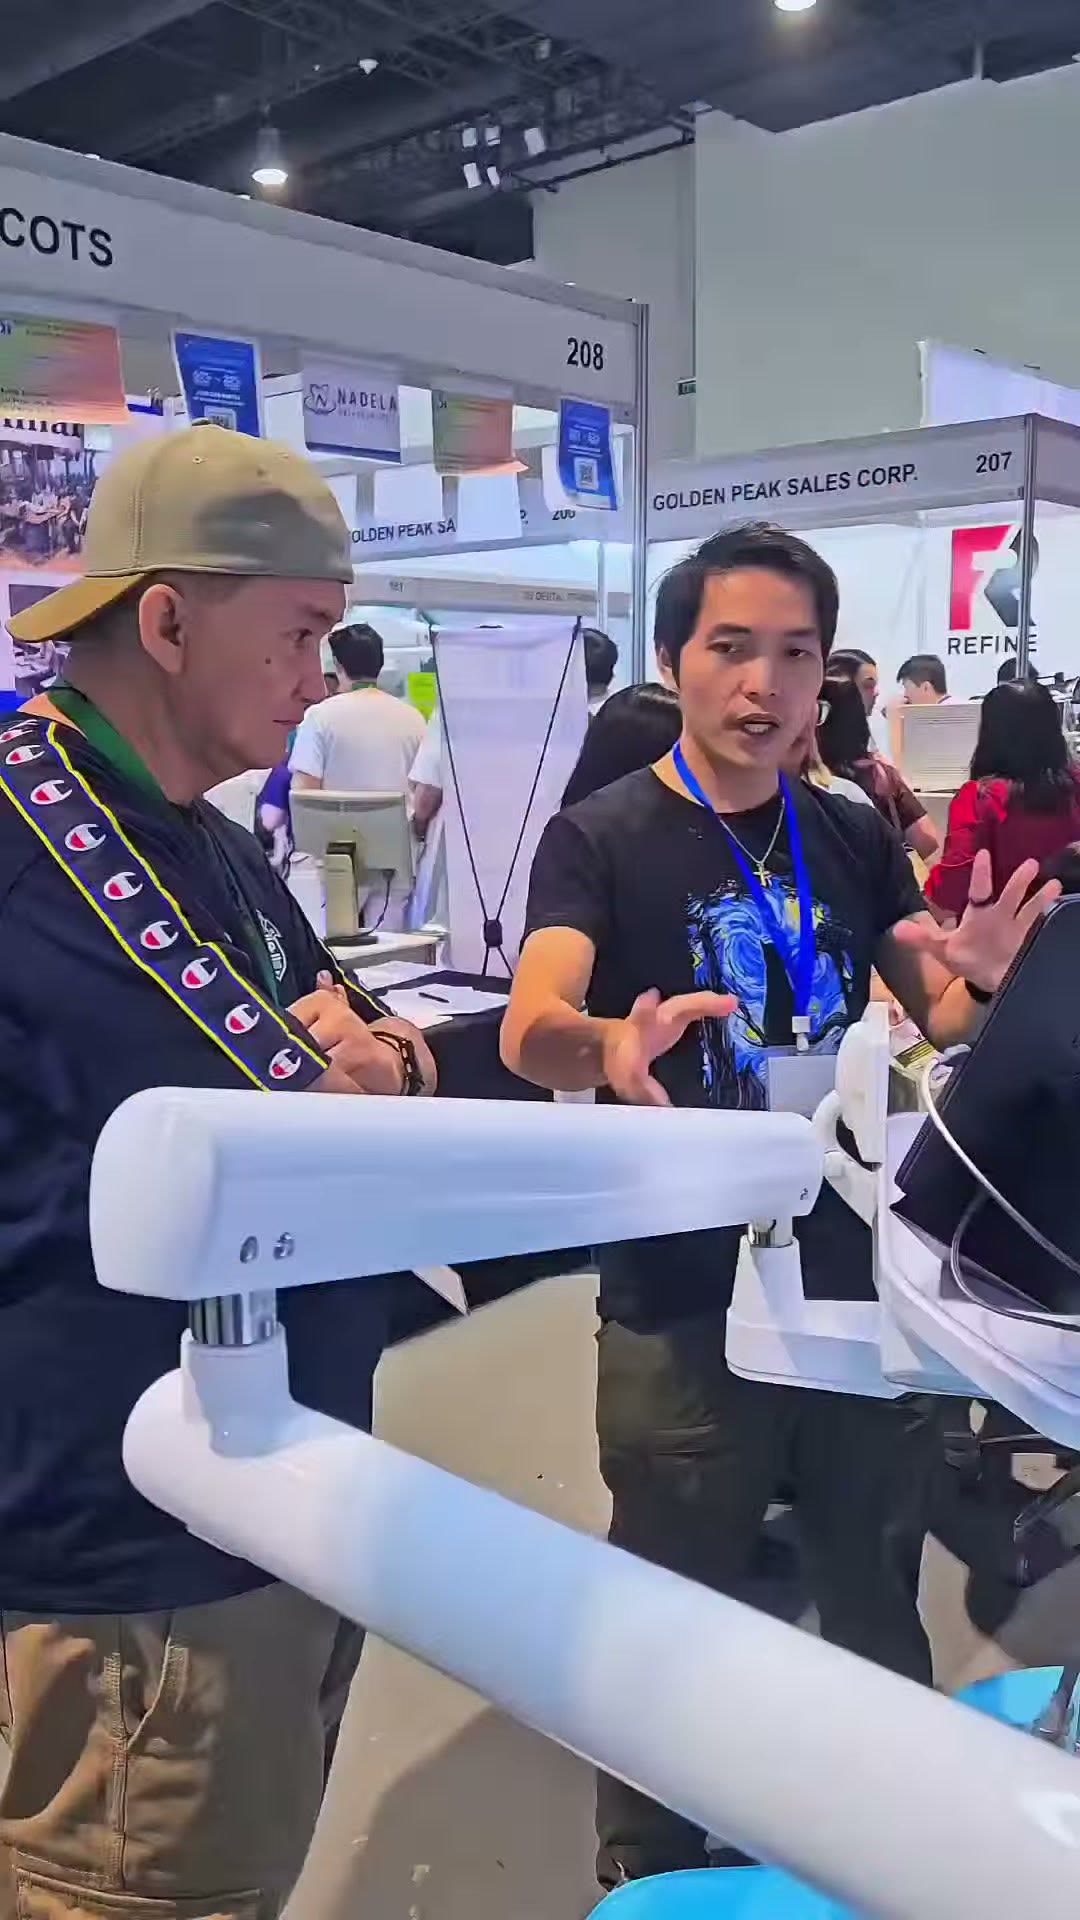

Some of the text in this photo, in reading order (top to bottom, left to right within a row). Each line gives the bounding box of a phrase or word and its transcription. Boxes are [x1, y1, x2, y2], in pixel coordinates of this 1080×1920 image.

[0, 208, 113, 268] COTS
[567, 337, 604, 371] 208
[337, 388, 397, 411] NADELA
[975, 451, 1012, 473] 207
[653, 463, 918, 511] GOLDEN PEAK SALES CORP.
[398, 521, 433, 539] PEAK
[947, 634, 1038, 655] REFINE
